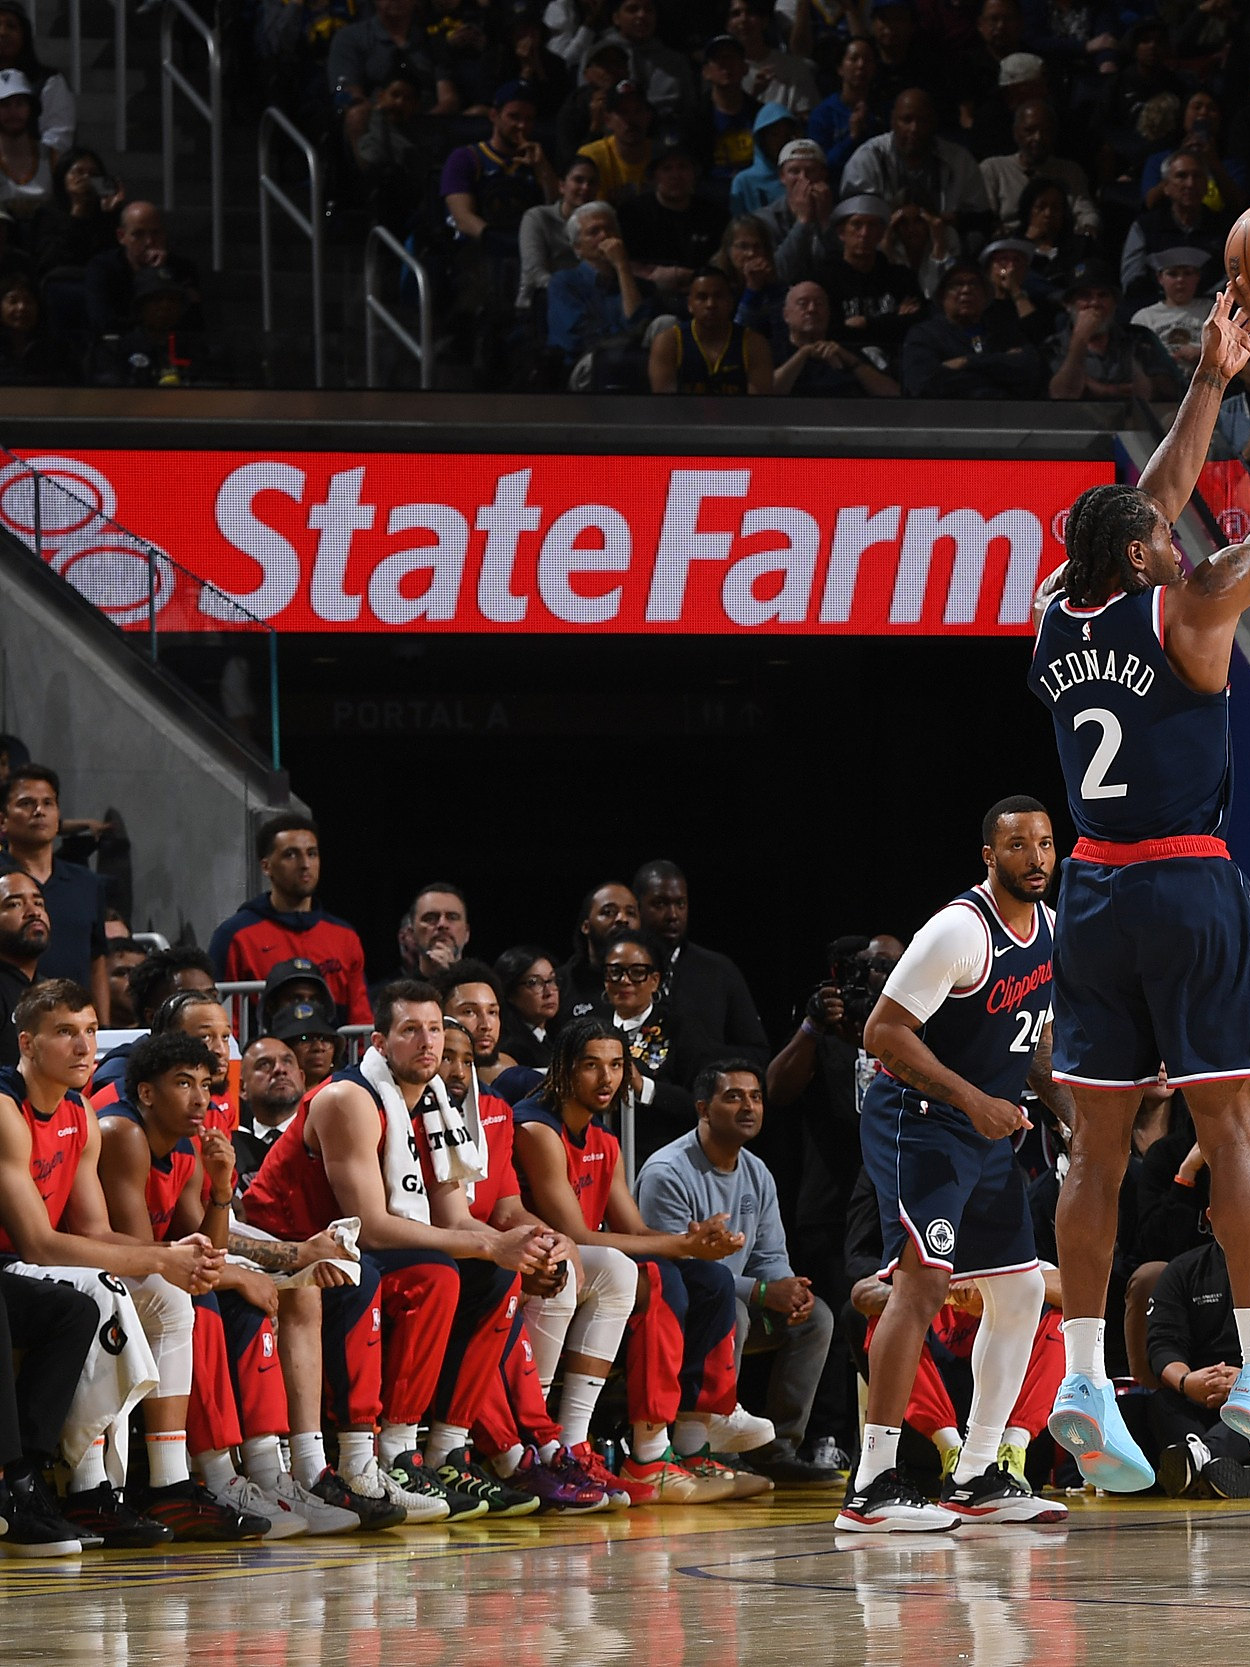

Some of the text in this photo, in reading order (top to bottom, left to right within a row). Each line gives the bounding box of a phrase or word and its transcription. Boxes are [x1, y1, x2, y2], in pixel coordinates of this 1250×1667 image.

[1040, 649, 1156, 702] LEONARD
[332, 700, 509, 730] PORTAL A
[1073, 707, 1129, 800] 2
[985, 959, 1053, 1015] Clippers
